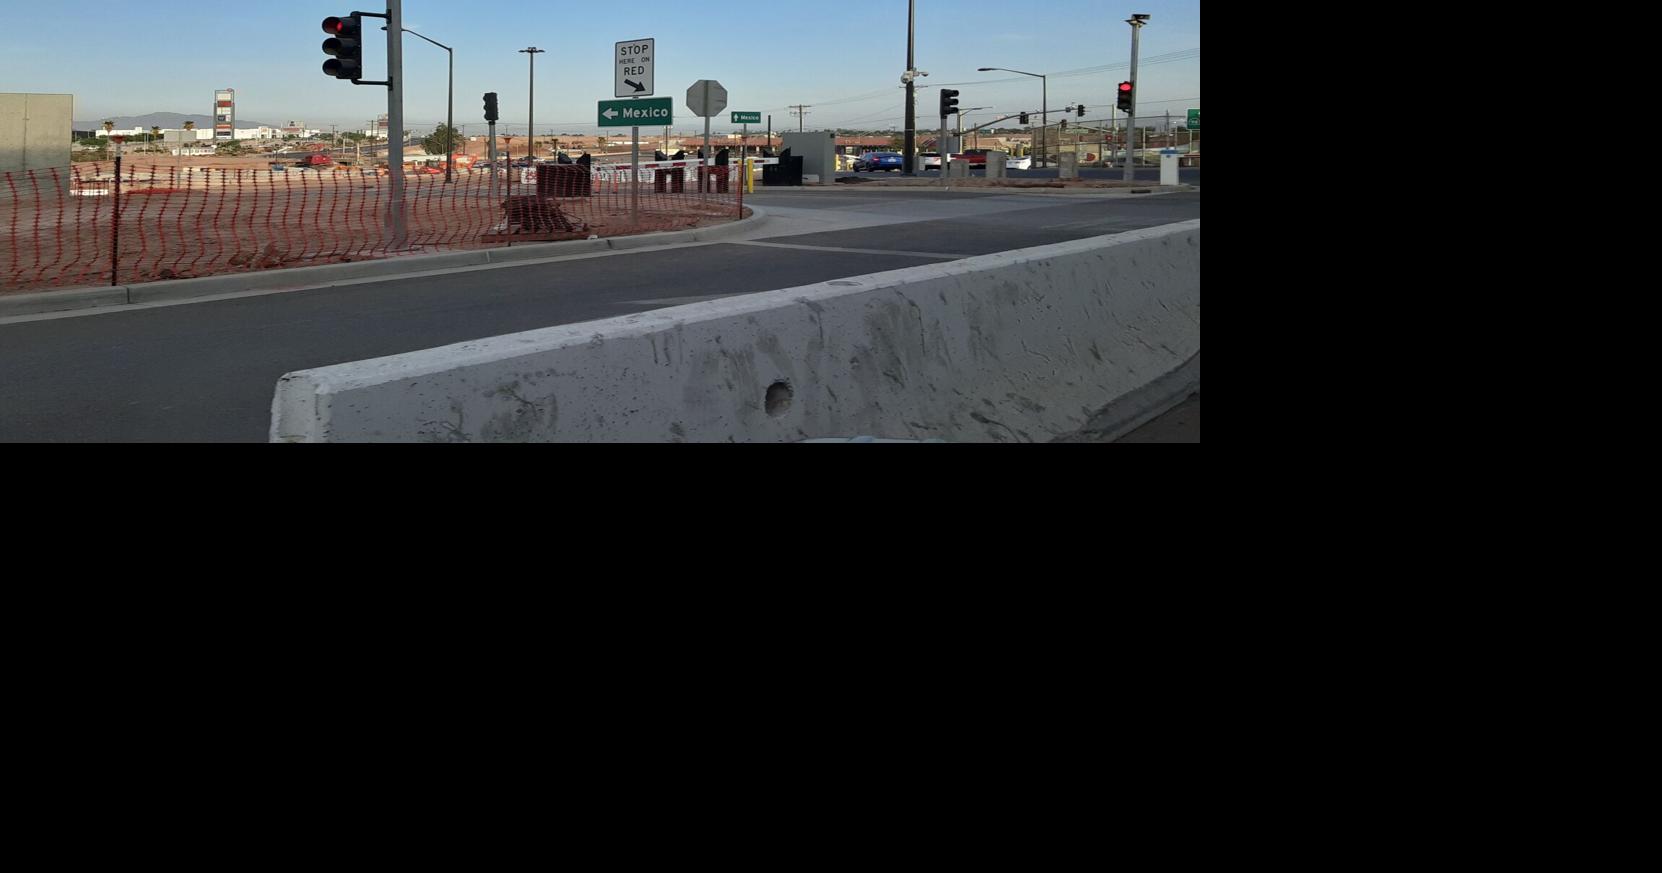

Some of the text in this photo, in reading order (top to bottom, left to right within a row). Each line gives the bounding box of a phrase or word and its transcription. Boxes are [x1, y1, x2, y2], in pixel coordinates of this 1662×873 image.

[621, 44, 648, 55] STOP
[624, 66, 644, 76] RED
[623, 107, 668, 118] Mexico
